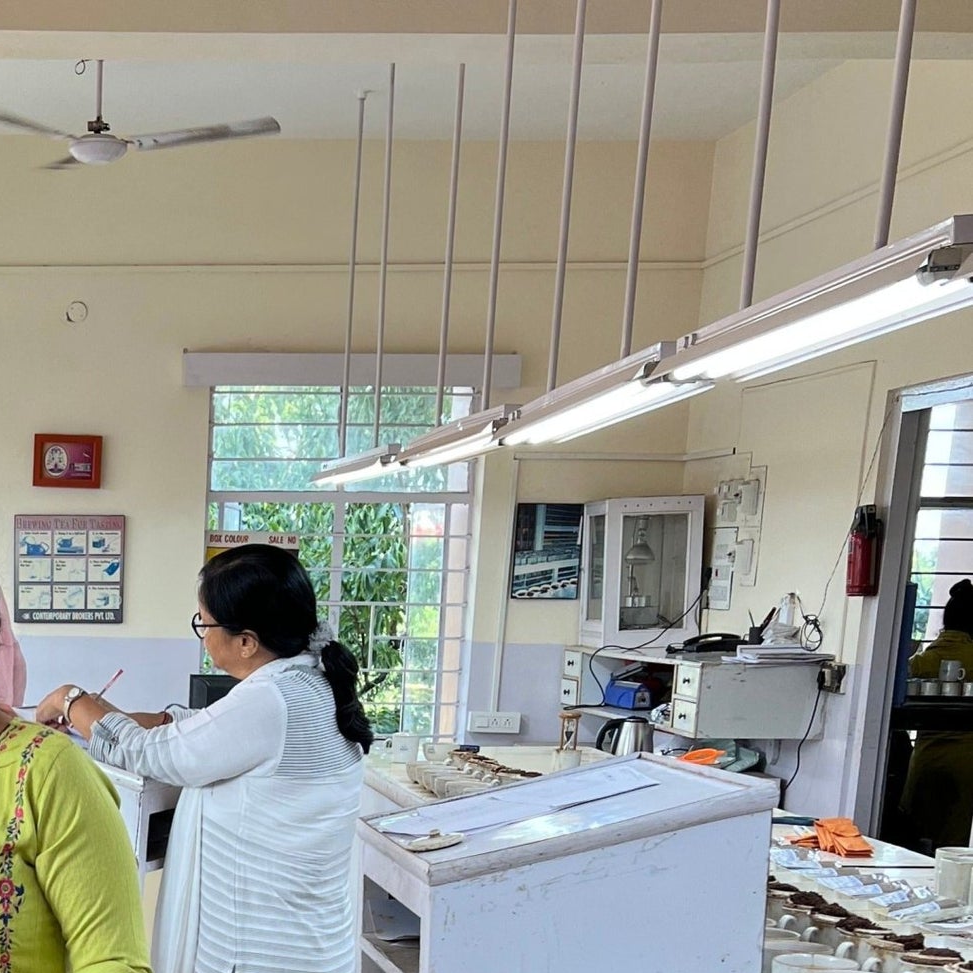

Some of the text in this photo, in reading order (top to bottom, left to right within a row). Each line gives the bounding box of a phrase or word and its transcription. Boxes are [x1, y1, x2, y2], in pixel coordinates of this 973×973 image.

[209, 534, 249, 544] BOX COLOUR
[268, 535, 297, 544] SALE NO
[32, 611, 71, 620] CONTEMPORARY
[71, 611, 94, 620] BROKERS
